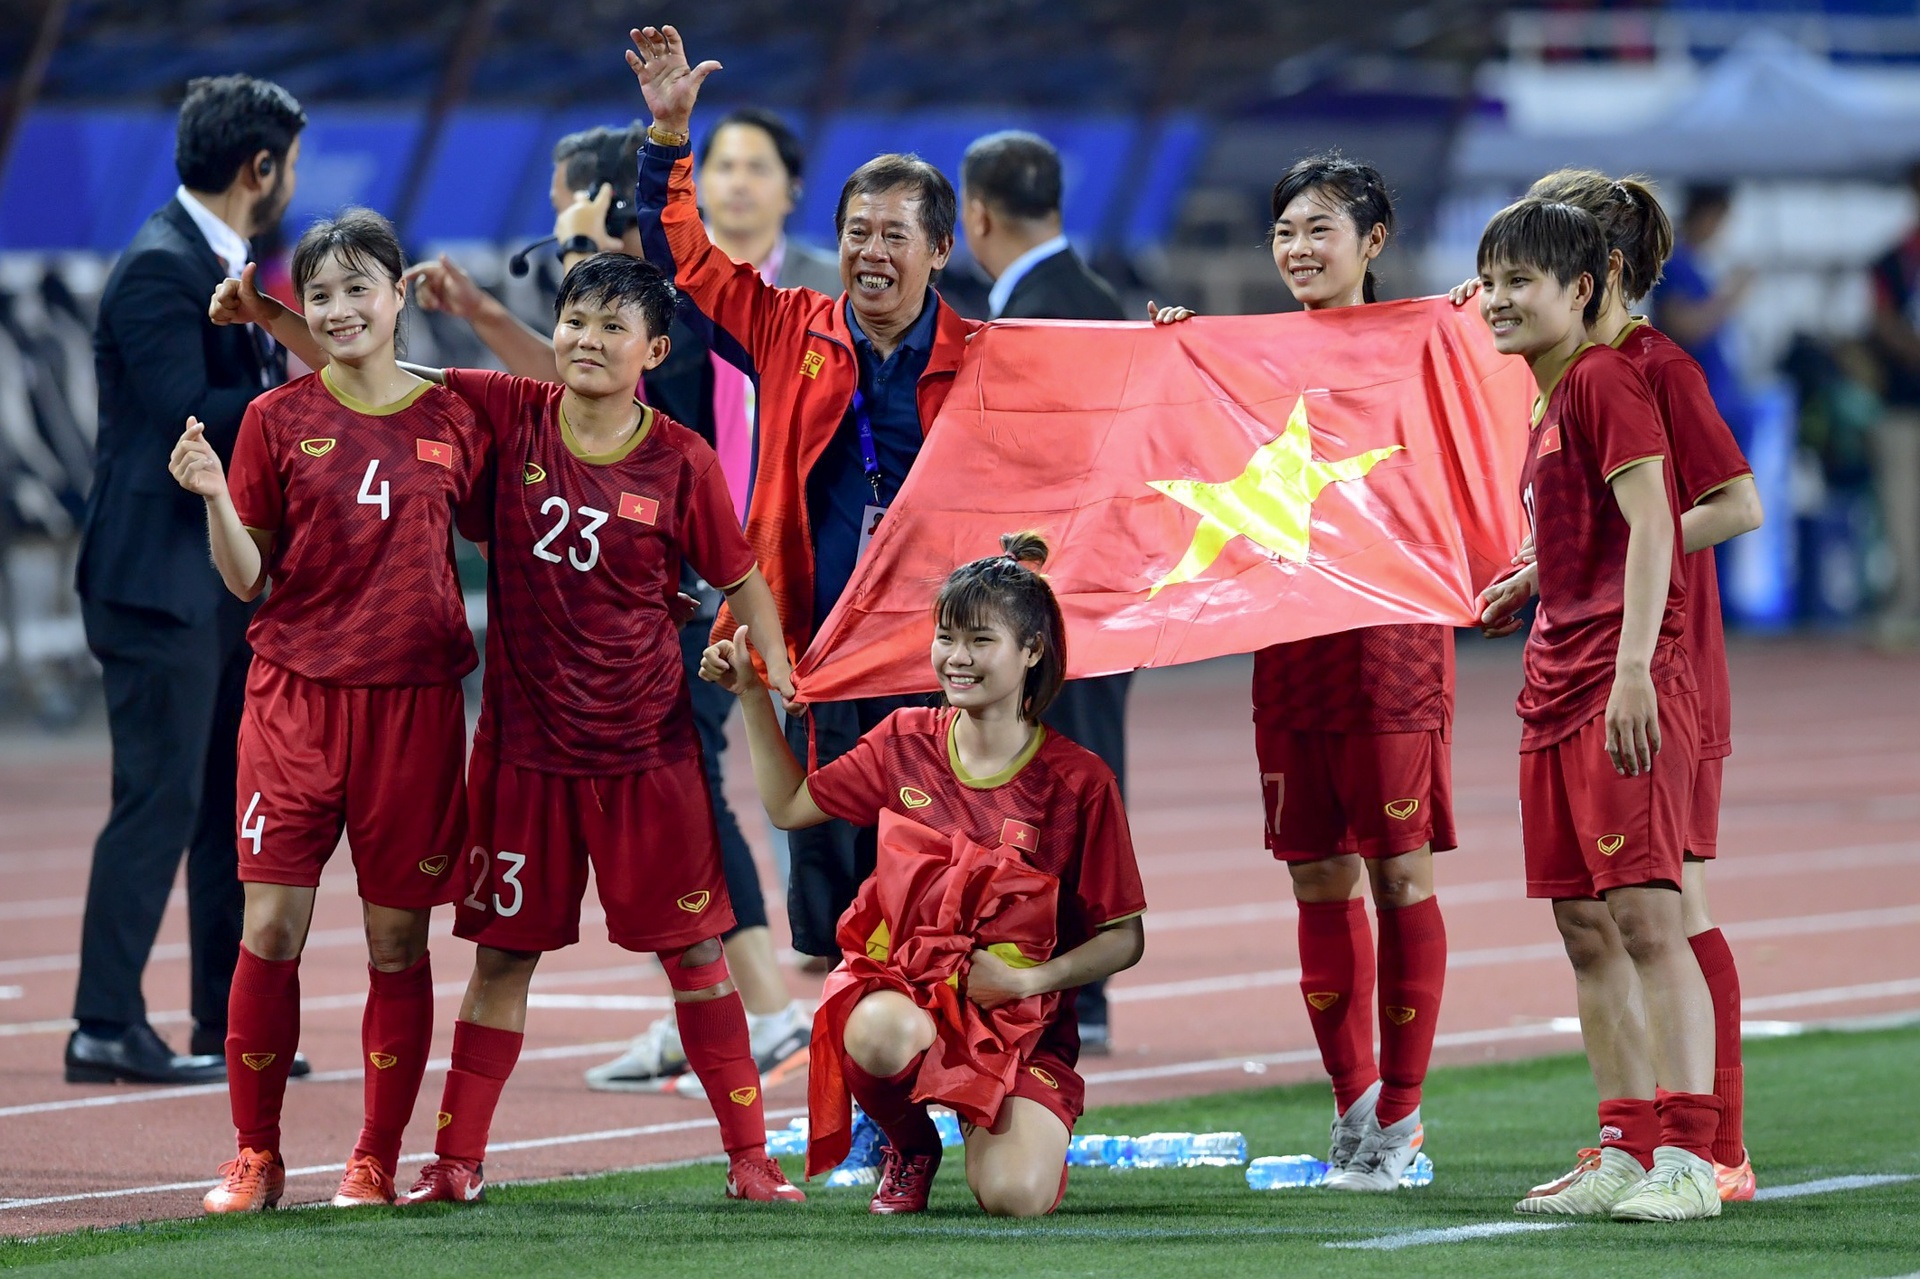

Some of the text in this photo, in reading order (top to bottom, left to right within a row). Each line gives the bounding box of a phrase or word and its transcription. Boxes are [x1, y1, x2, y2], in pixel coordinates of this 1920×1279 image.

[357, 459, 390, 520] 4
[533, 496, 609, 571] 23
[241, 792, 266, 855] 4
[1260, 772, 1285, 835] 7
[463, 845, 526, 917] 23
